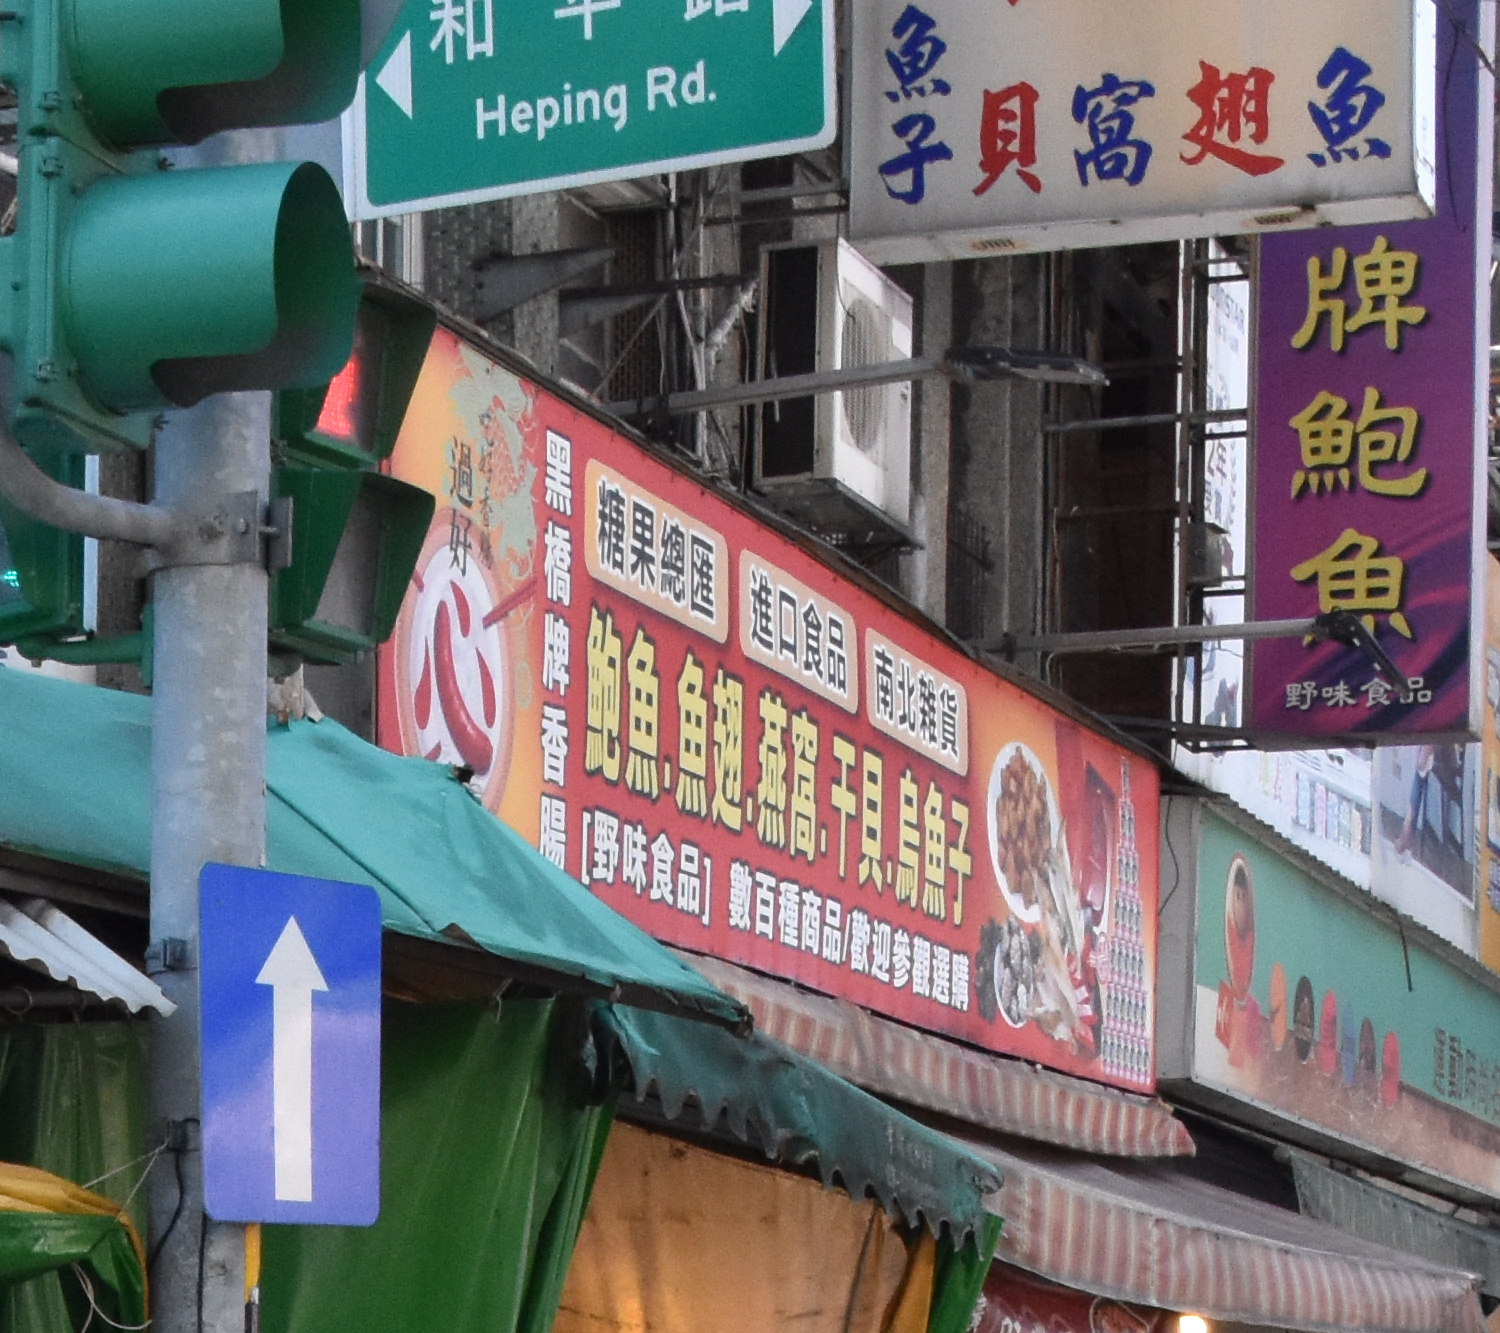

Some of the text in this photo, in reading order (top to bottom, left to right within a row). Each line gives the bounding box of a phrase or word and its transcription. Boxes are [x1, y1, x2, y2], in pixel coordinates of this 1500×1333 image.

[475, 61, 717, 141] Heping Rd.
[1288, 233, 1431, 648] 牌鮑魚
[596, 476, 716, 622] 糖果總匯
[538, 429, 572, 869] 黑橋牌香腸
[750, 565, 848, 697] 進口食品
[1285, 676, 1433, 711] 野味食品
[872, 644, 960, 760] 南北雜貨
